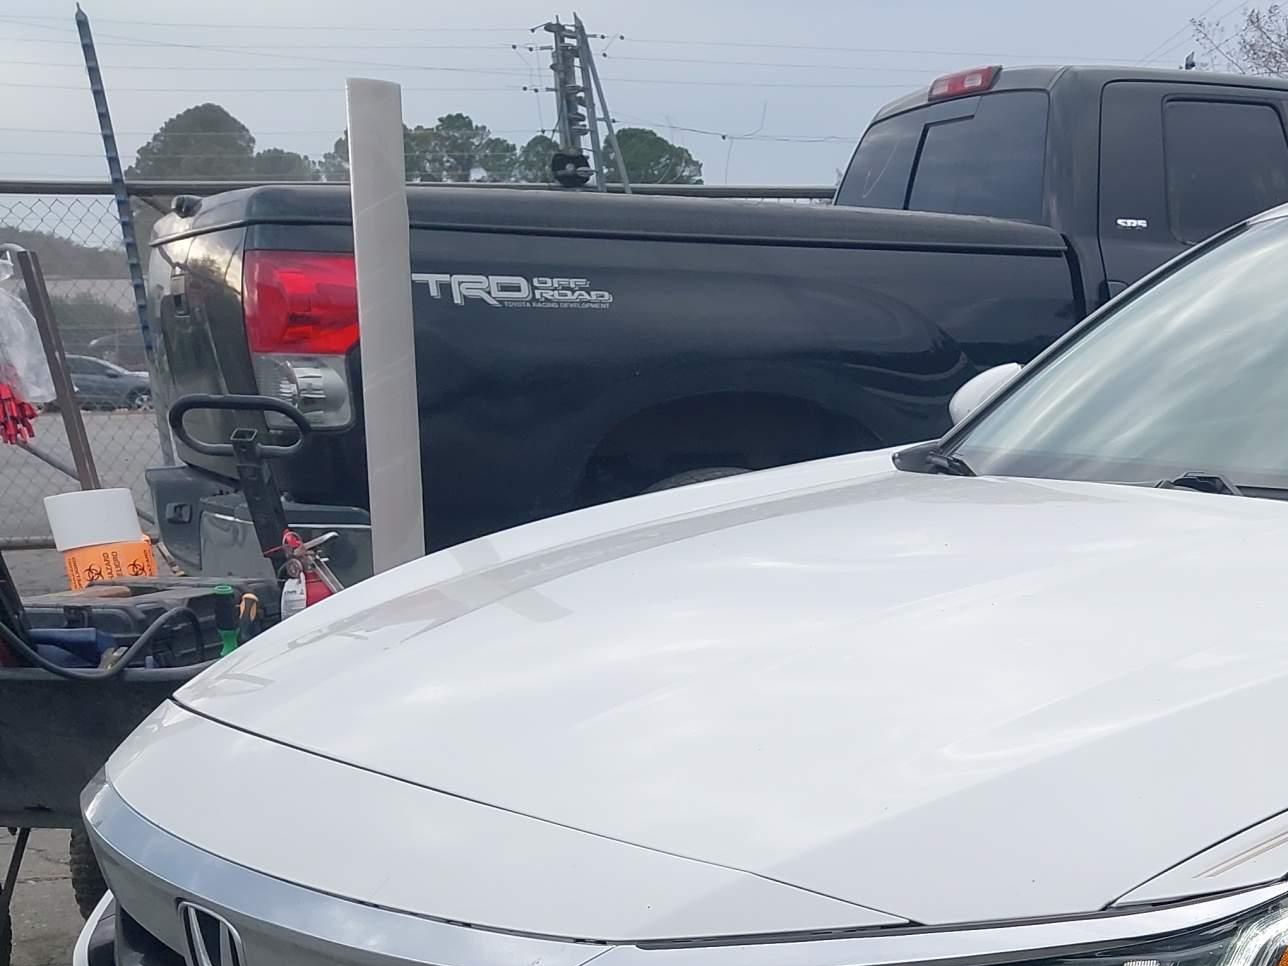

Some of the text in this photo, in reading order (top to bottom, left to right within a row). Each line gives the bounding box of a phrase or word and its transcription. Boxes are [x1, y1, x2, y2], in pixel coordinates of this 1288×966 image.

[411, 272, 534, 308] TRD
[532, 277, 590, 290] OFF
[534, 289, 613, 303] ROAD
